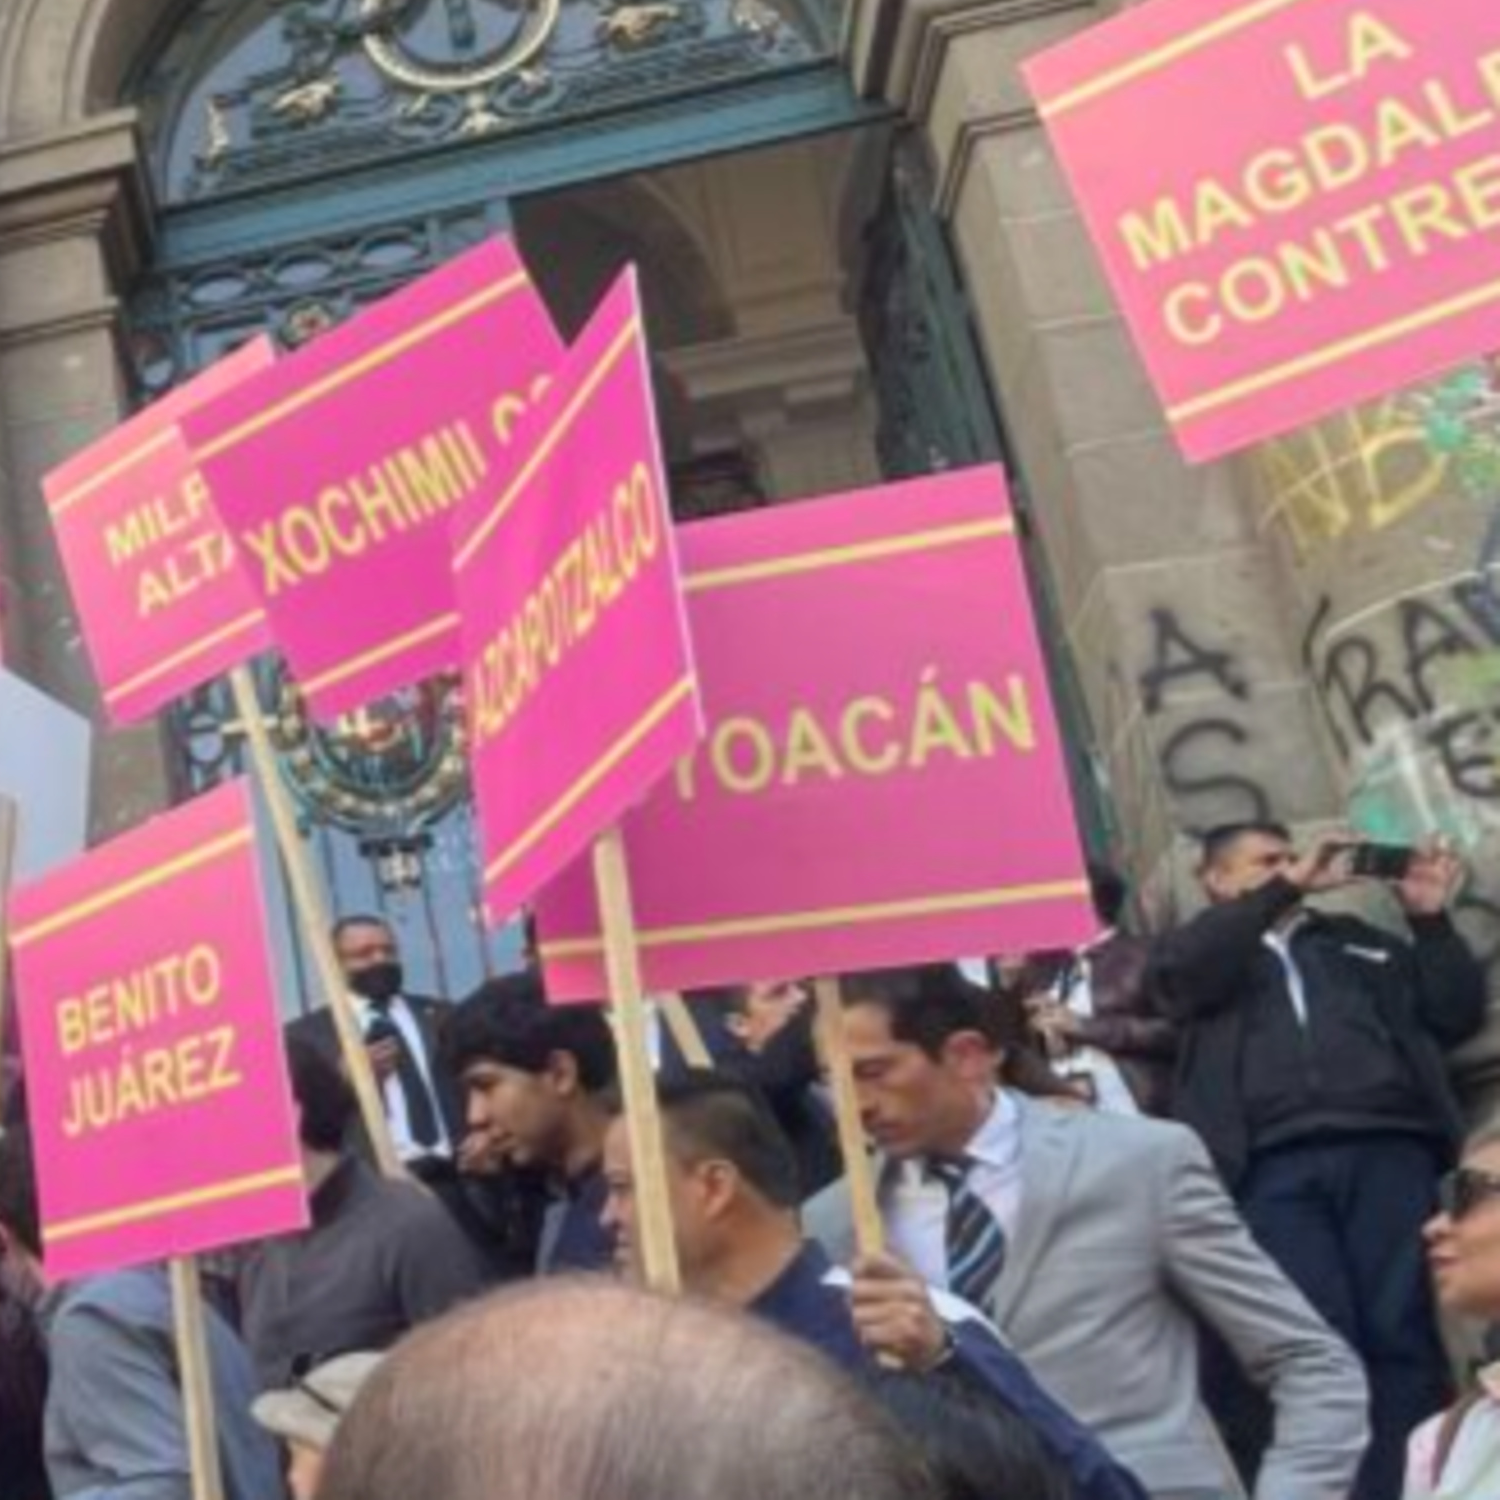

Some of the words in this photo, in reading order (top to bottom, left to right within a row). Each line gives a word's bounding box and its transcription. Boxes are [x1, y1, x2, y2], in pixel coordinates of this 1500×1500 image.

[1285, 11, 1411, 100] LA
[1162, 154, 1500, 346] CONTRE
[106, 470, 210, 566] MILP
[242, 374, 552, 596] XOCHIMIL
[676, 664, 1038, 802] OACÁN
[56, 944, 221, 1055] BENITO
[61, 1026, 242, 1137] JUÁREZ
